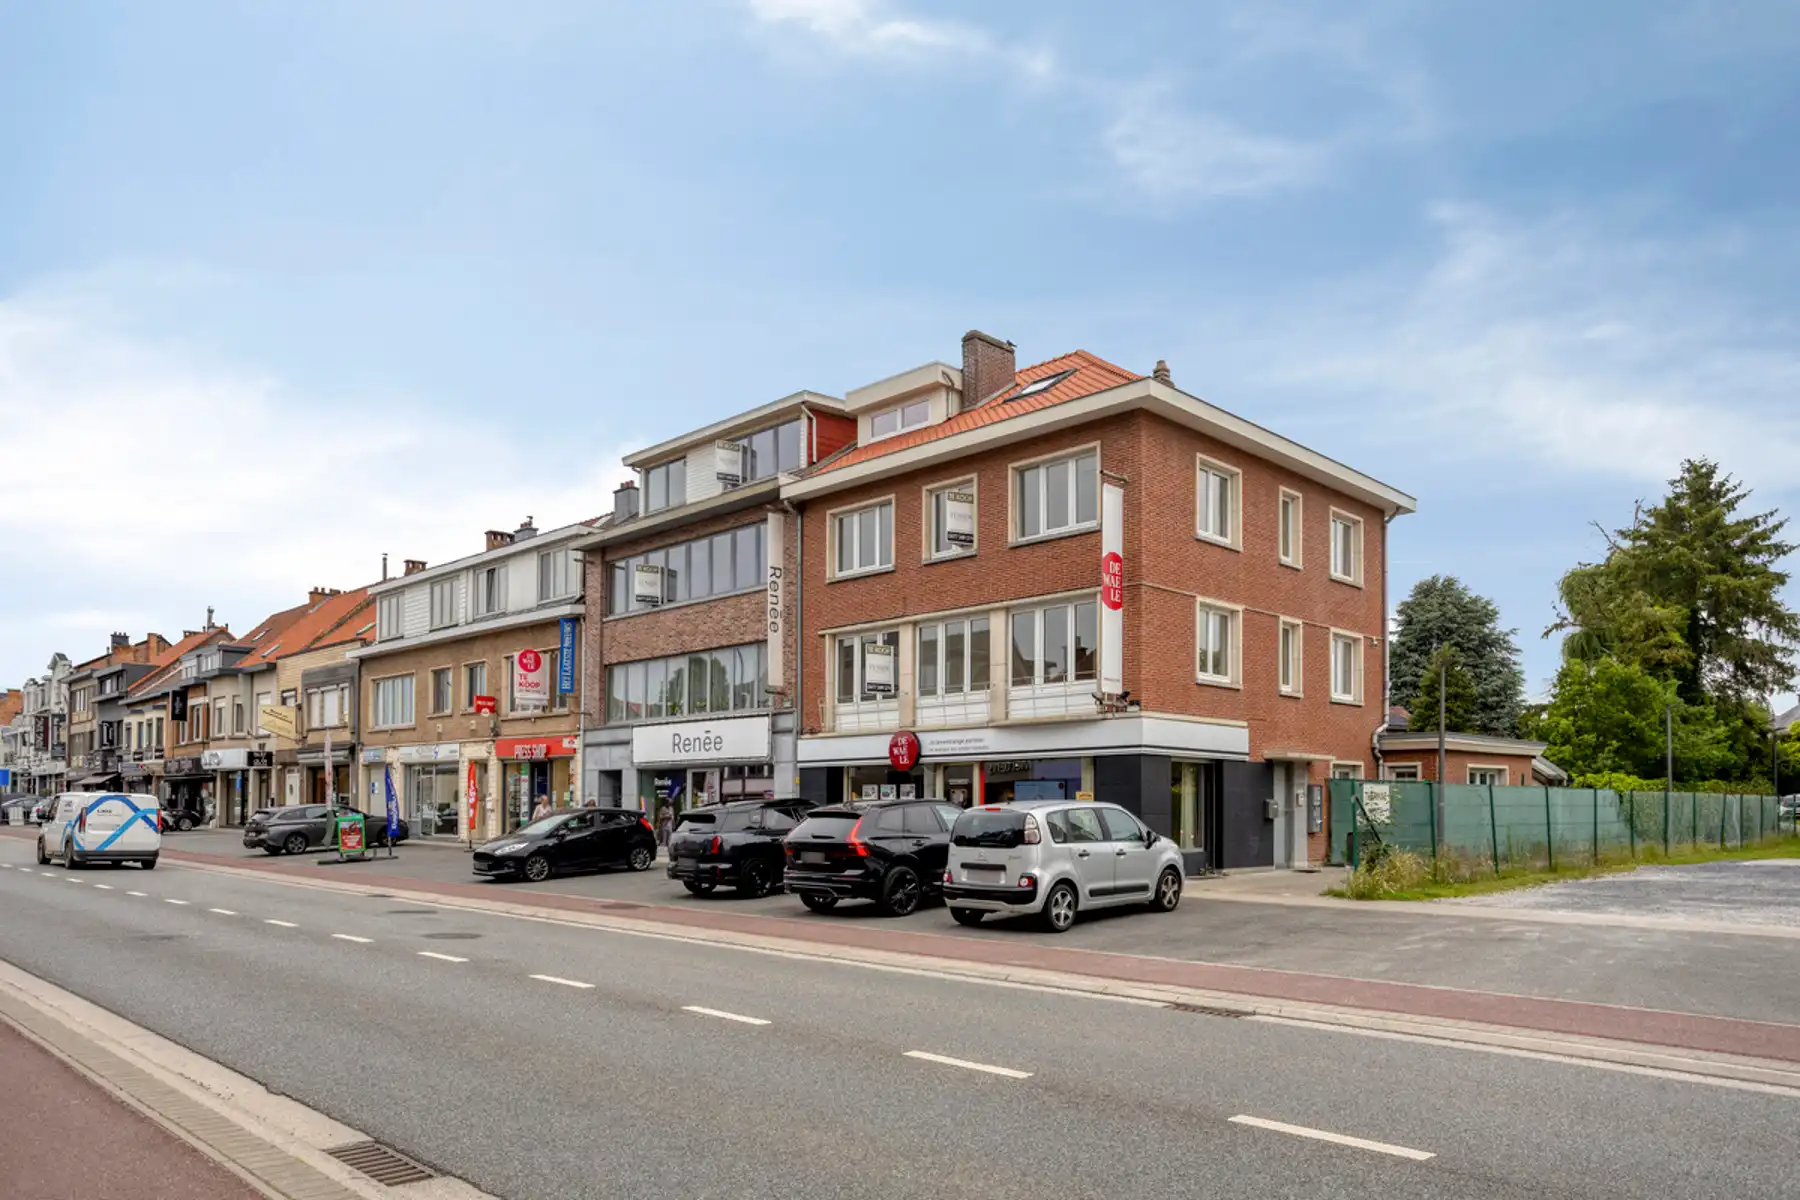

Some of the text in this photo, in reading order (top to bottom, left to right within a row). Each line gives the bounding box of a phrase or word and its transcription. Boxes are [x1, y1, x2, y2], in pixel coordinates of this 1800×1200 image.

[1109, 561, 1121, 575] DE
[1103, 573, 1120, 588] WAE
[1110, 588, 1120, 602] LE
[520, 673, 528, 681] TE
[898, 736, 908, 746] DE
[514, 744, 547, 760] PRESS SHOP
[900, 755, 909, 764] LE
